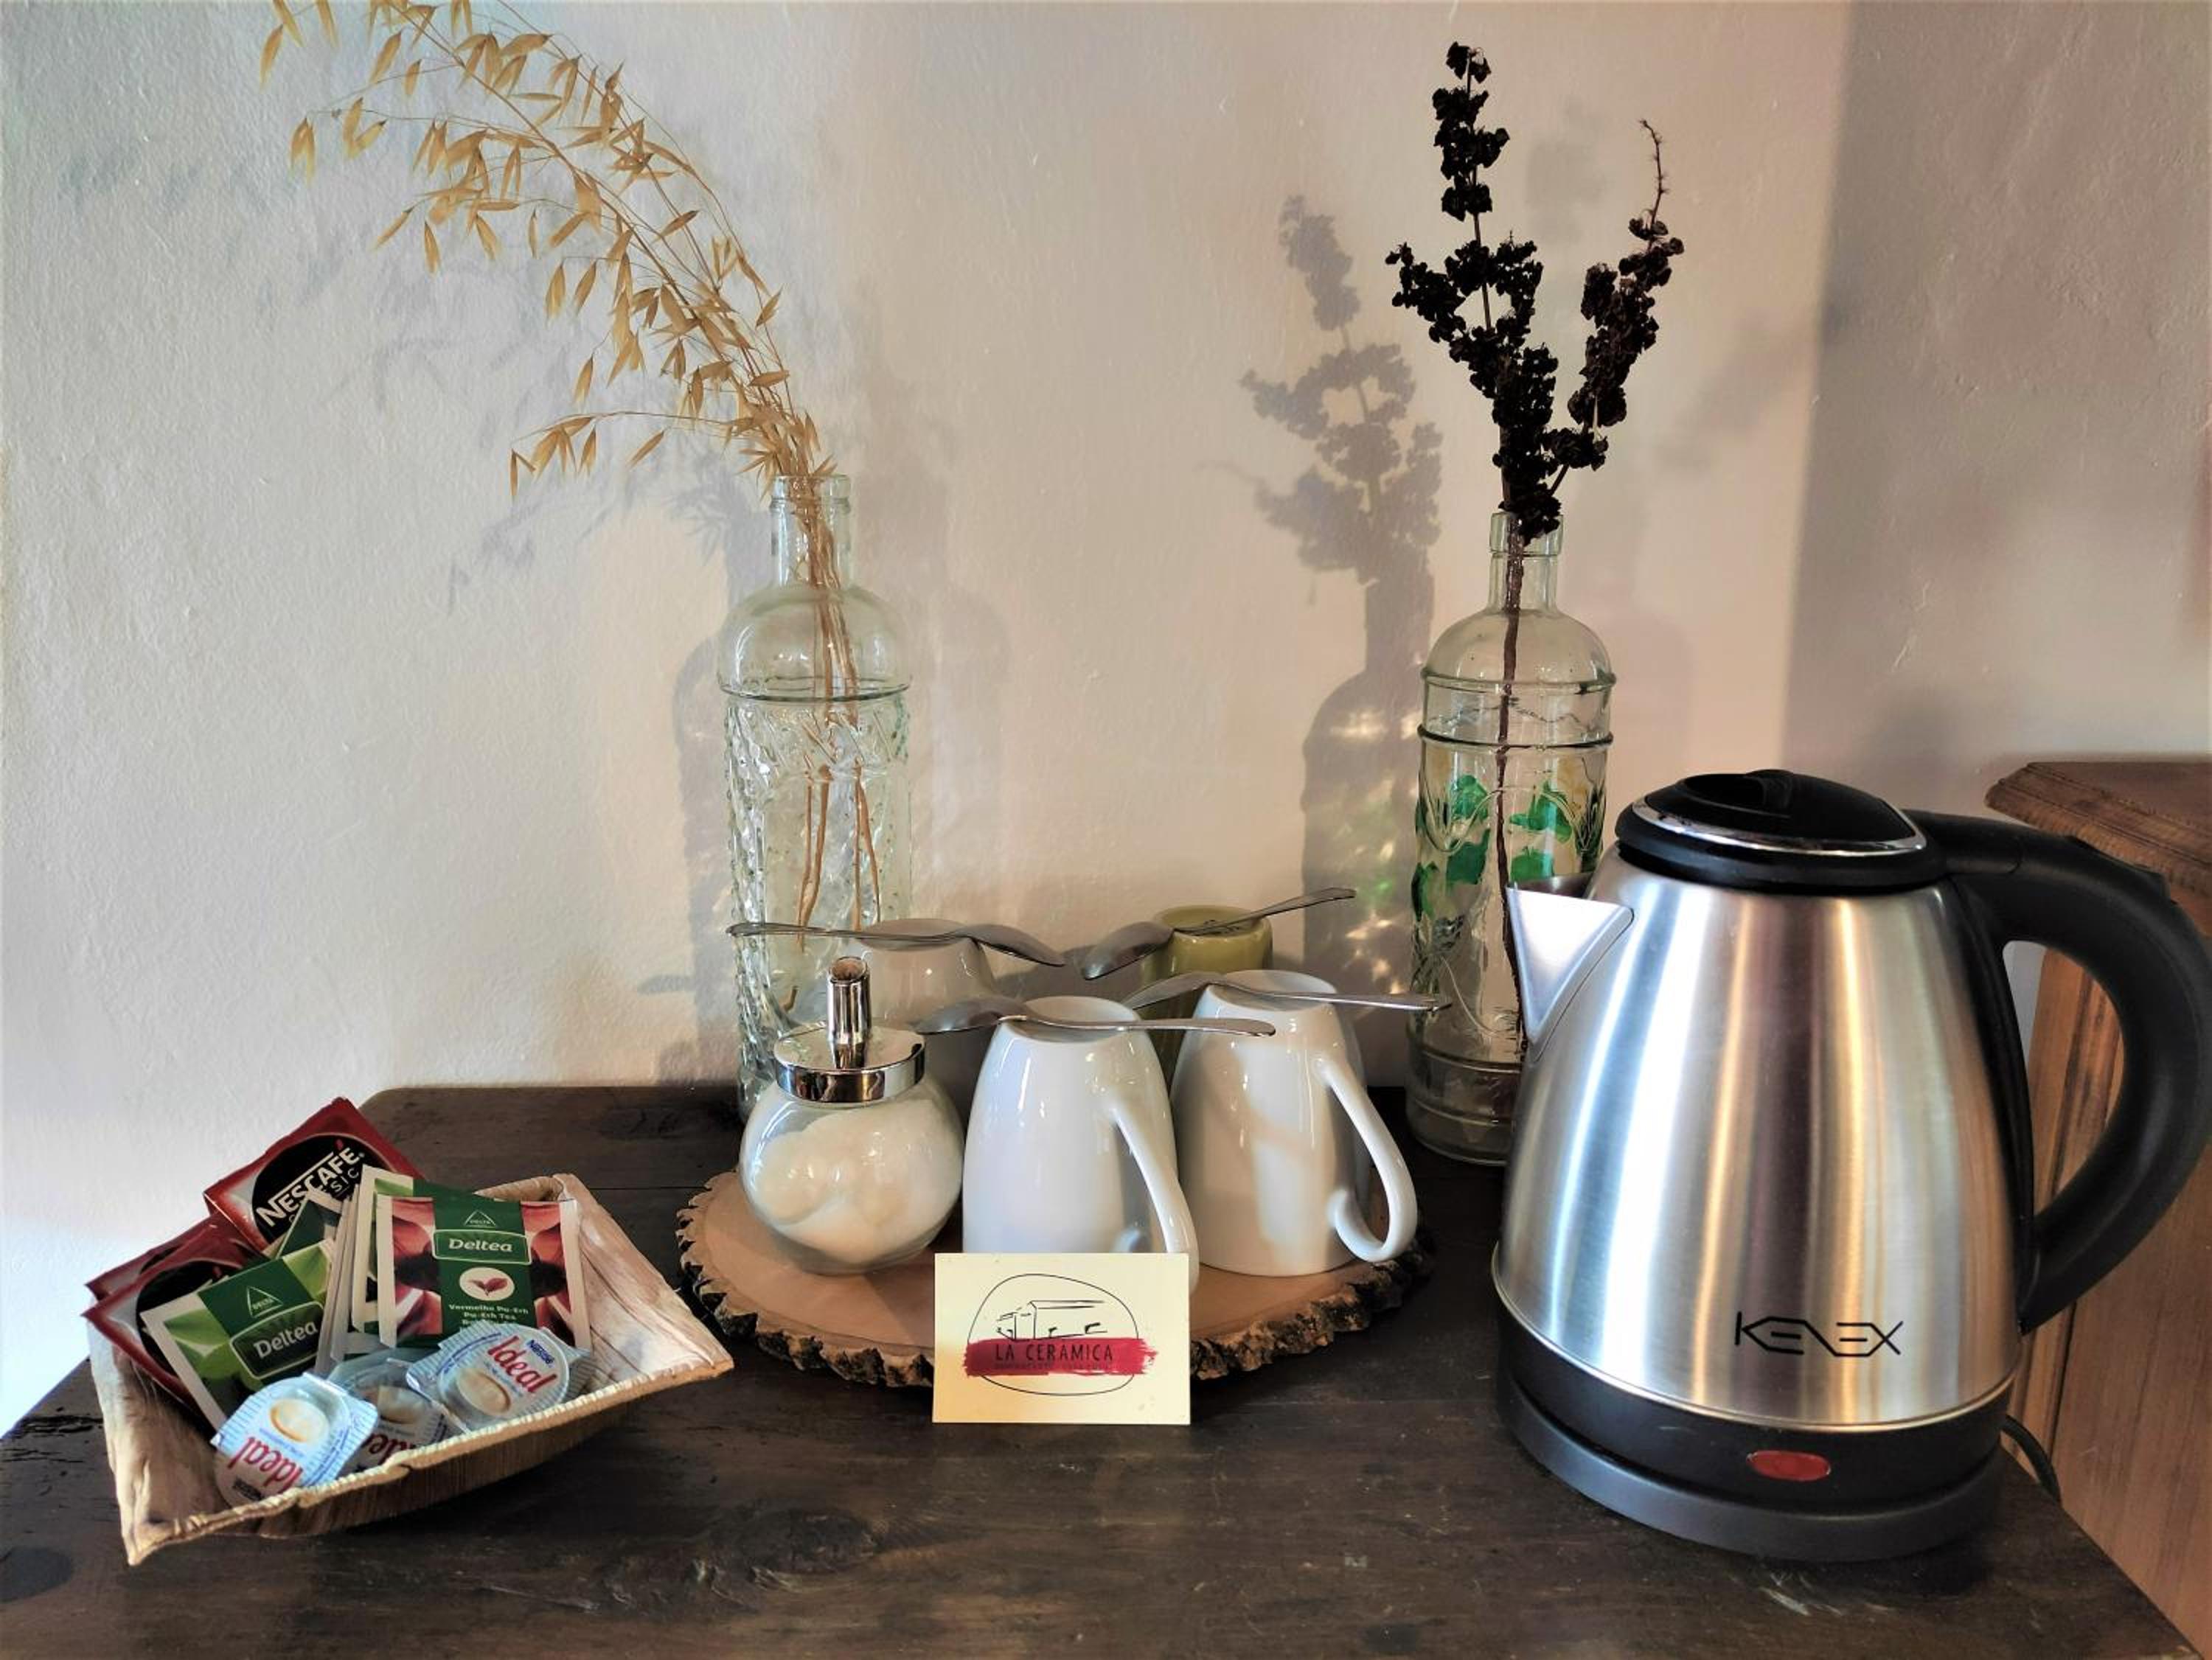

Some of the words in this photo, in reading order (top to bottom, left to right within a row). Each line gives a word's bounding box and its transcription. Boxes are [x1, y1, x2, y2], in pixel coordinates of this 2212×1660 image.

[448, 1238, 513, 1252] Deltea
[253, 1321, 319, 1360] Deltea
[995, 1344, 1015, 1361] LA
[1026, 1344, 1113, 1361] CERAMICA
[487, 1335, 558, 1393] Ideal
[227, 1437, 304, 1494] Ideal
